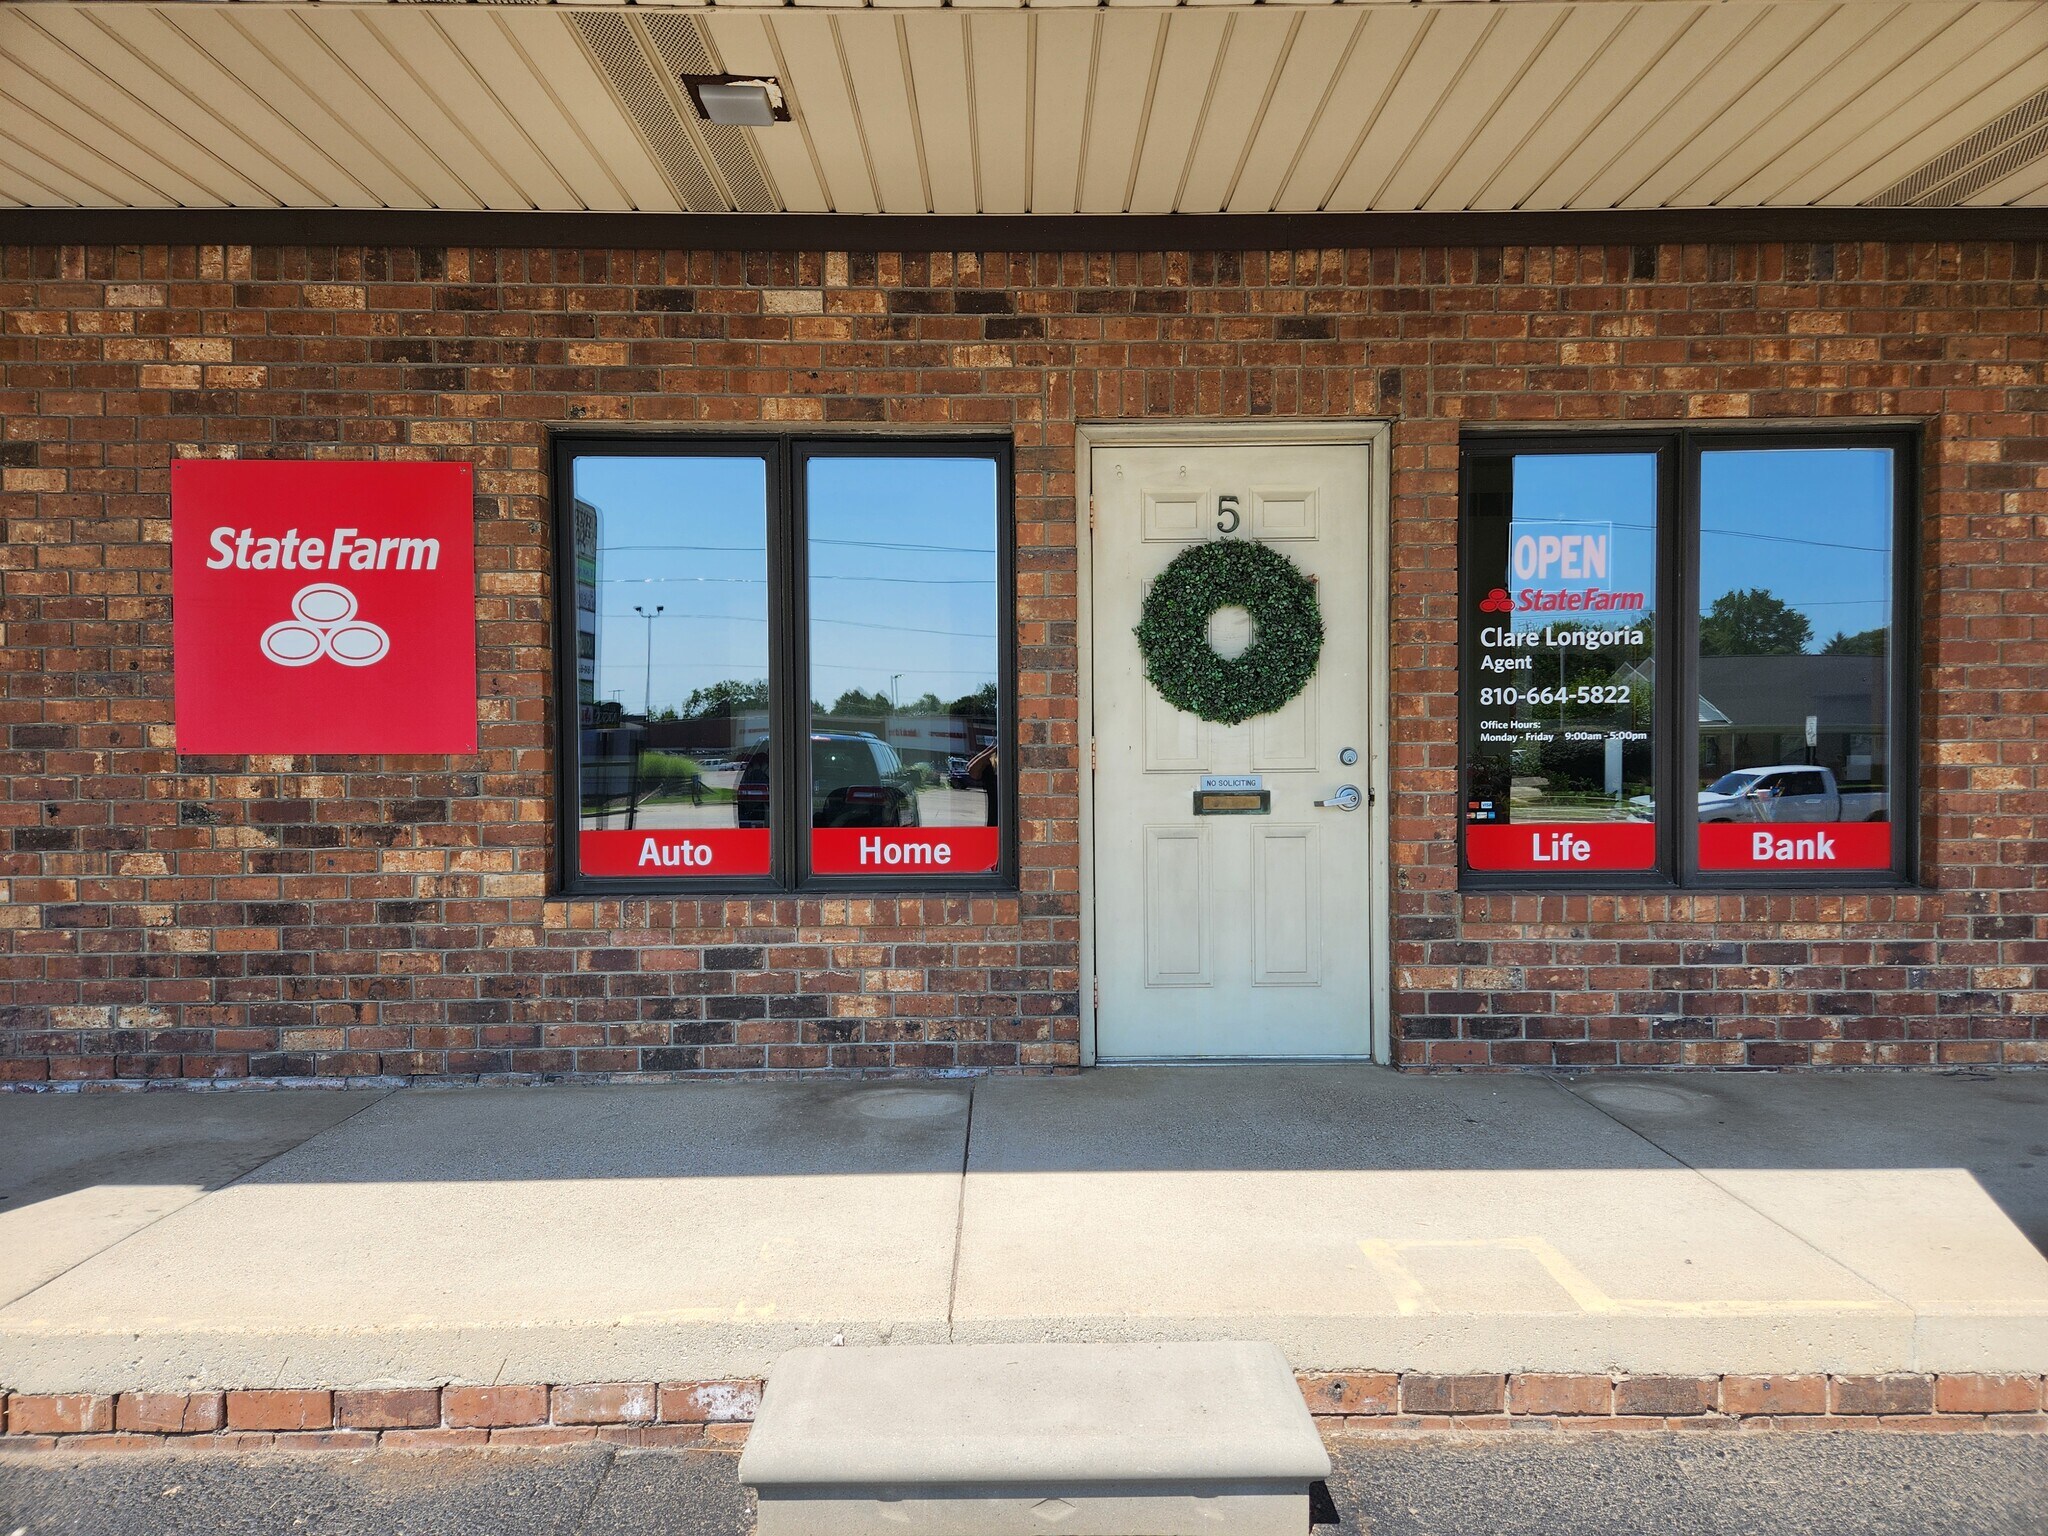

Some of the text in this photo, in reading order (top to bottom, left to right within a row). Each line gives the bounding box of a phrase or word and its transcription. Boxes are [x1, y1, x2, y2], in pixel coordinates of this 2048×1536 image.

[1217, 495, 1241, 533] 5
[1514, 535, 1606, 580] OPEN
[1480, 626, 1643, 650] Clare Longoria
[1480, 655, 1532, 673] Agent
[1480, 686, 1630, 705] 810-664-5822
[1480, 720, 1541, 729] Office Hours:
[1480, 733, 1517, 743] Monday
[1526, 733, 1554, 743] Friday
[1565, 732, 1602, 740] 9:00am
[1610, 731, 1647, 742] 5:00pm
[1206, 779, 1256, 787] NO SOLICITING
[638, 838, 713, 866] Auto
[859, 836, 951, 864] Home
[1532, 833, 1591, 861] Life
[1752, 832, 1836, 860] Bank
